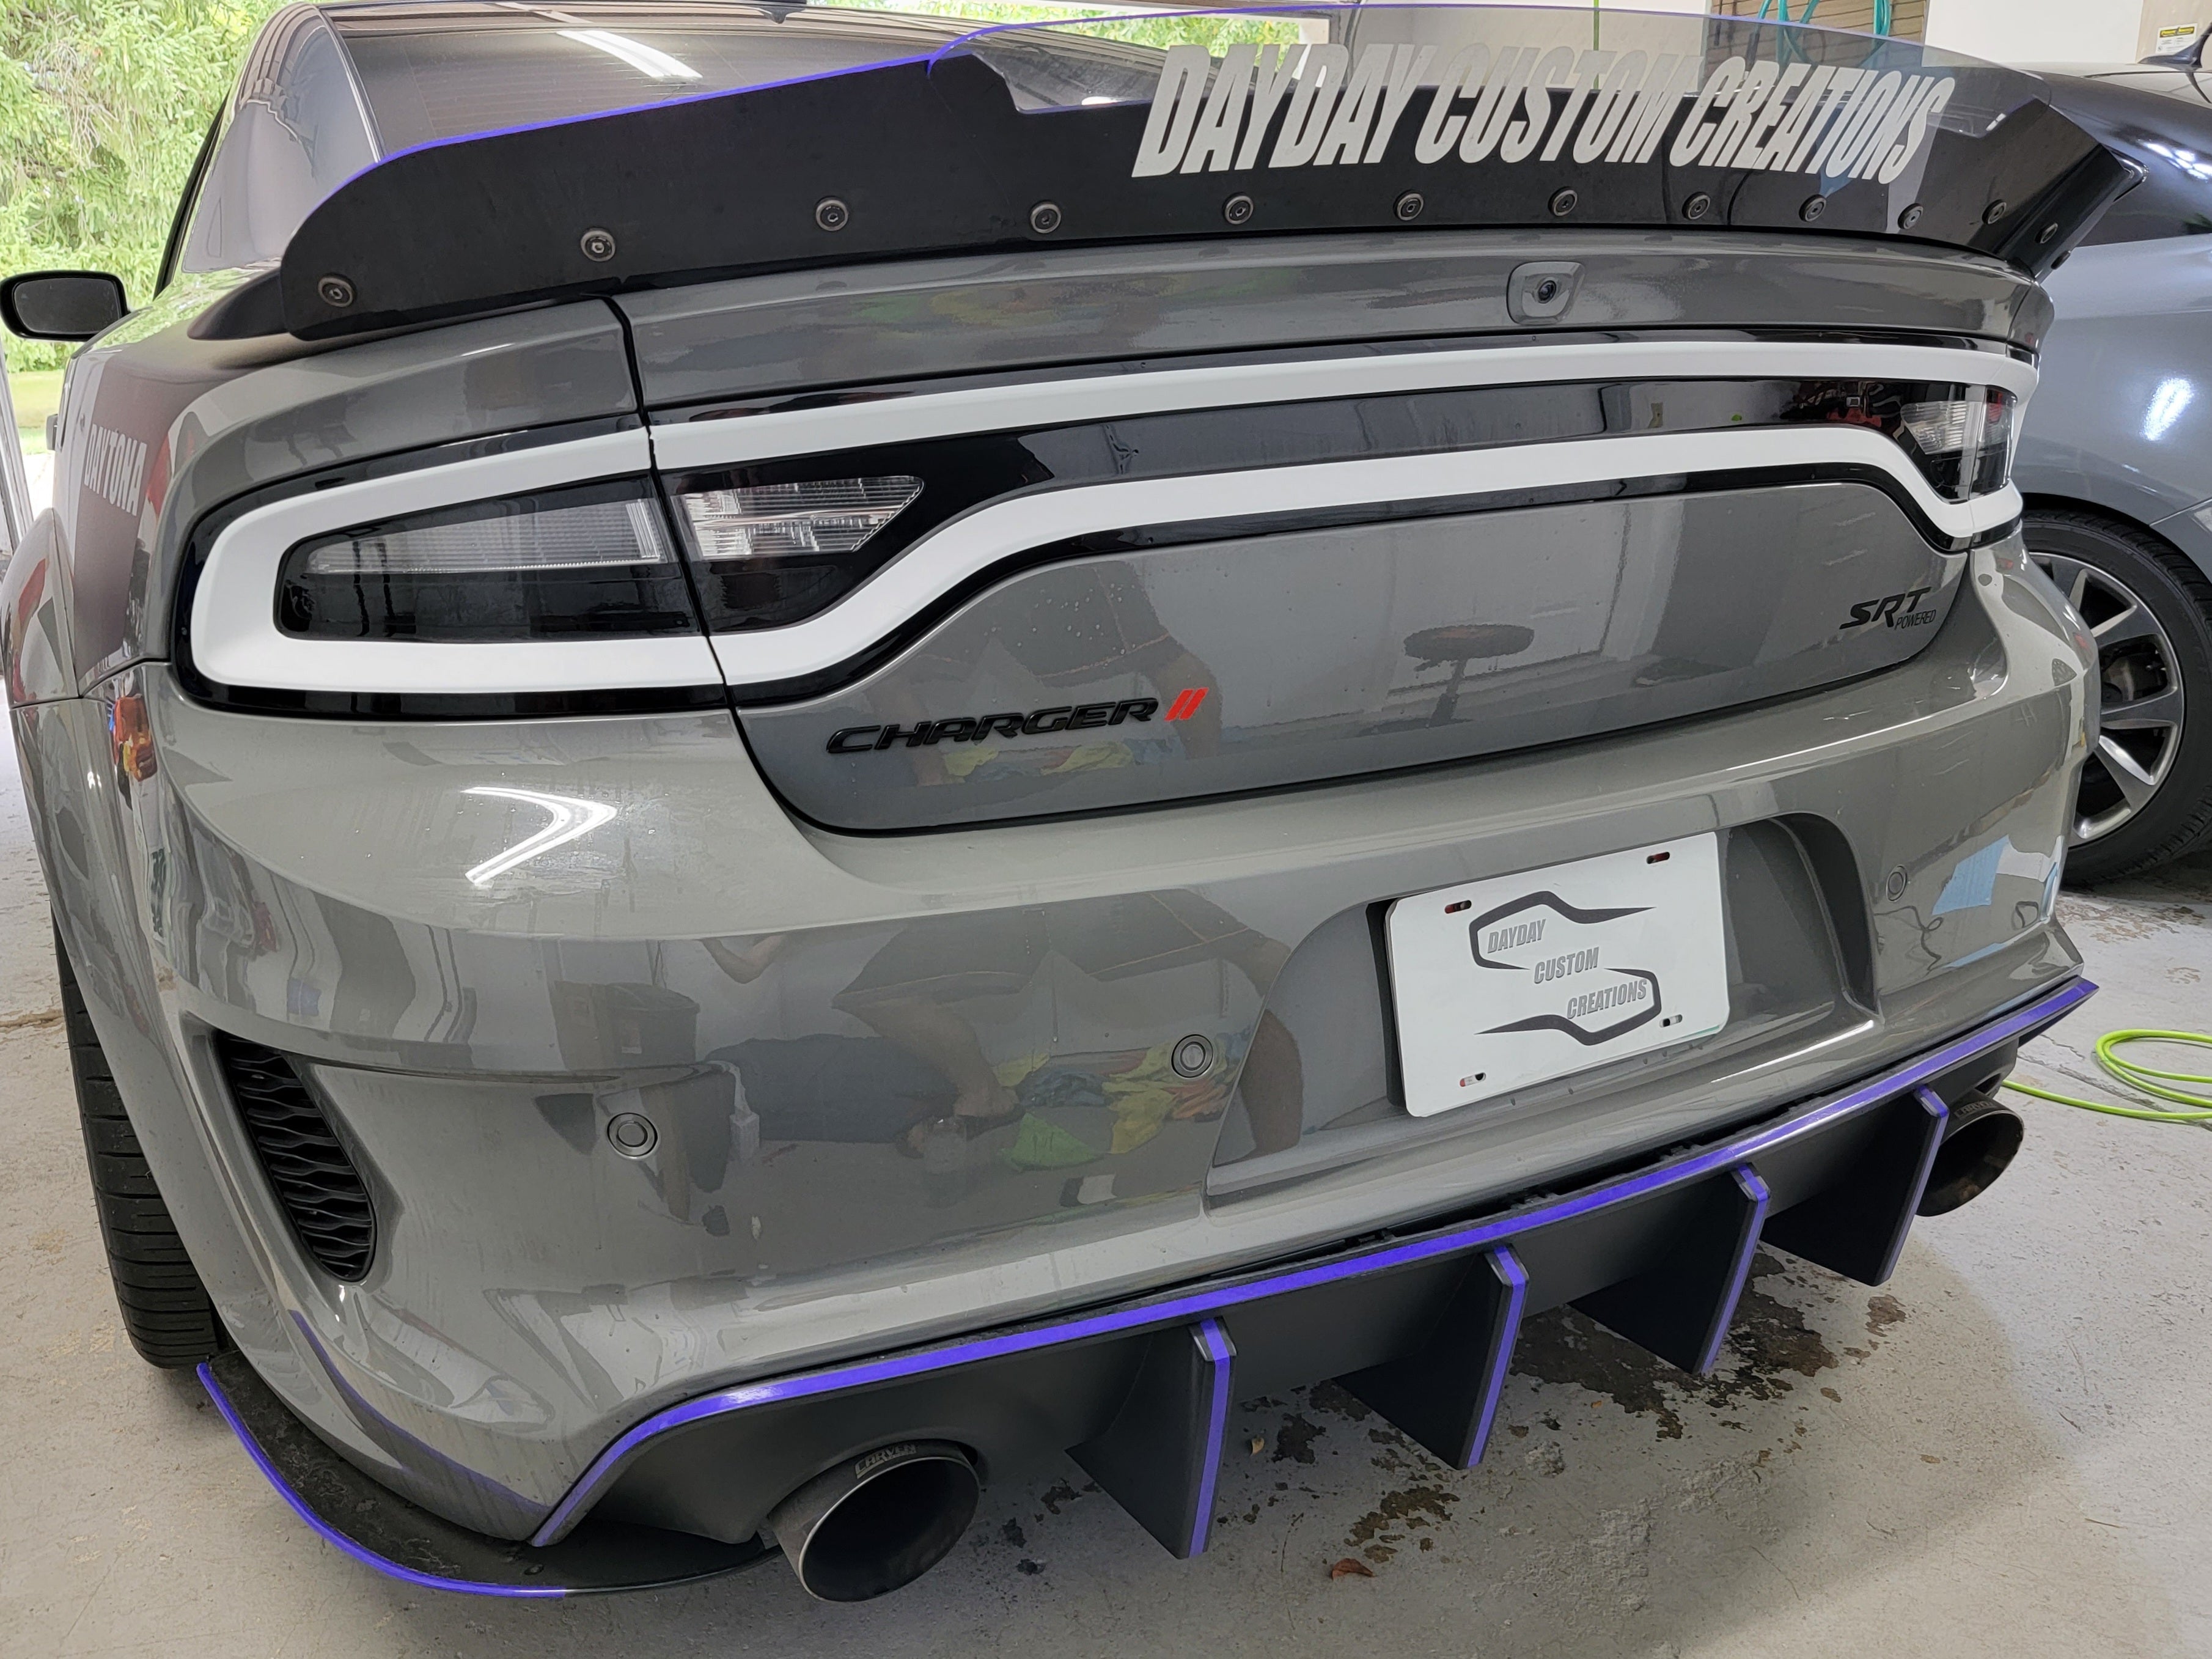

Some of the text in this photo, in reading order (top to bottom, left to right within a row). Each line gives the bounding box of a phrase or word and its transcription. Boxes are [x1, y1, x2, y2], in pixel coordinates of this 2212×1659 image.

[1131, 42, 1955, 184] DAYDAY CUSTOM CREATIONS
[84, 424, 147, 517] DAYTONA
[1839, 586, 1932, 630] SRT
[1894, 609, 1937, 630] POWERED
[826, 697, 1159, 754] CHARGER
[1487, 918, 1546, 954] DAYDAY
[1534, 946, 1600, 984] CUSTOM
[1567, 979, 1647, 1020] CREATIONS
[854, 1444, 917, 1477] CARVEN
